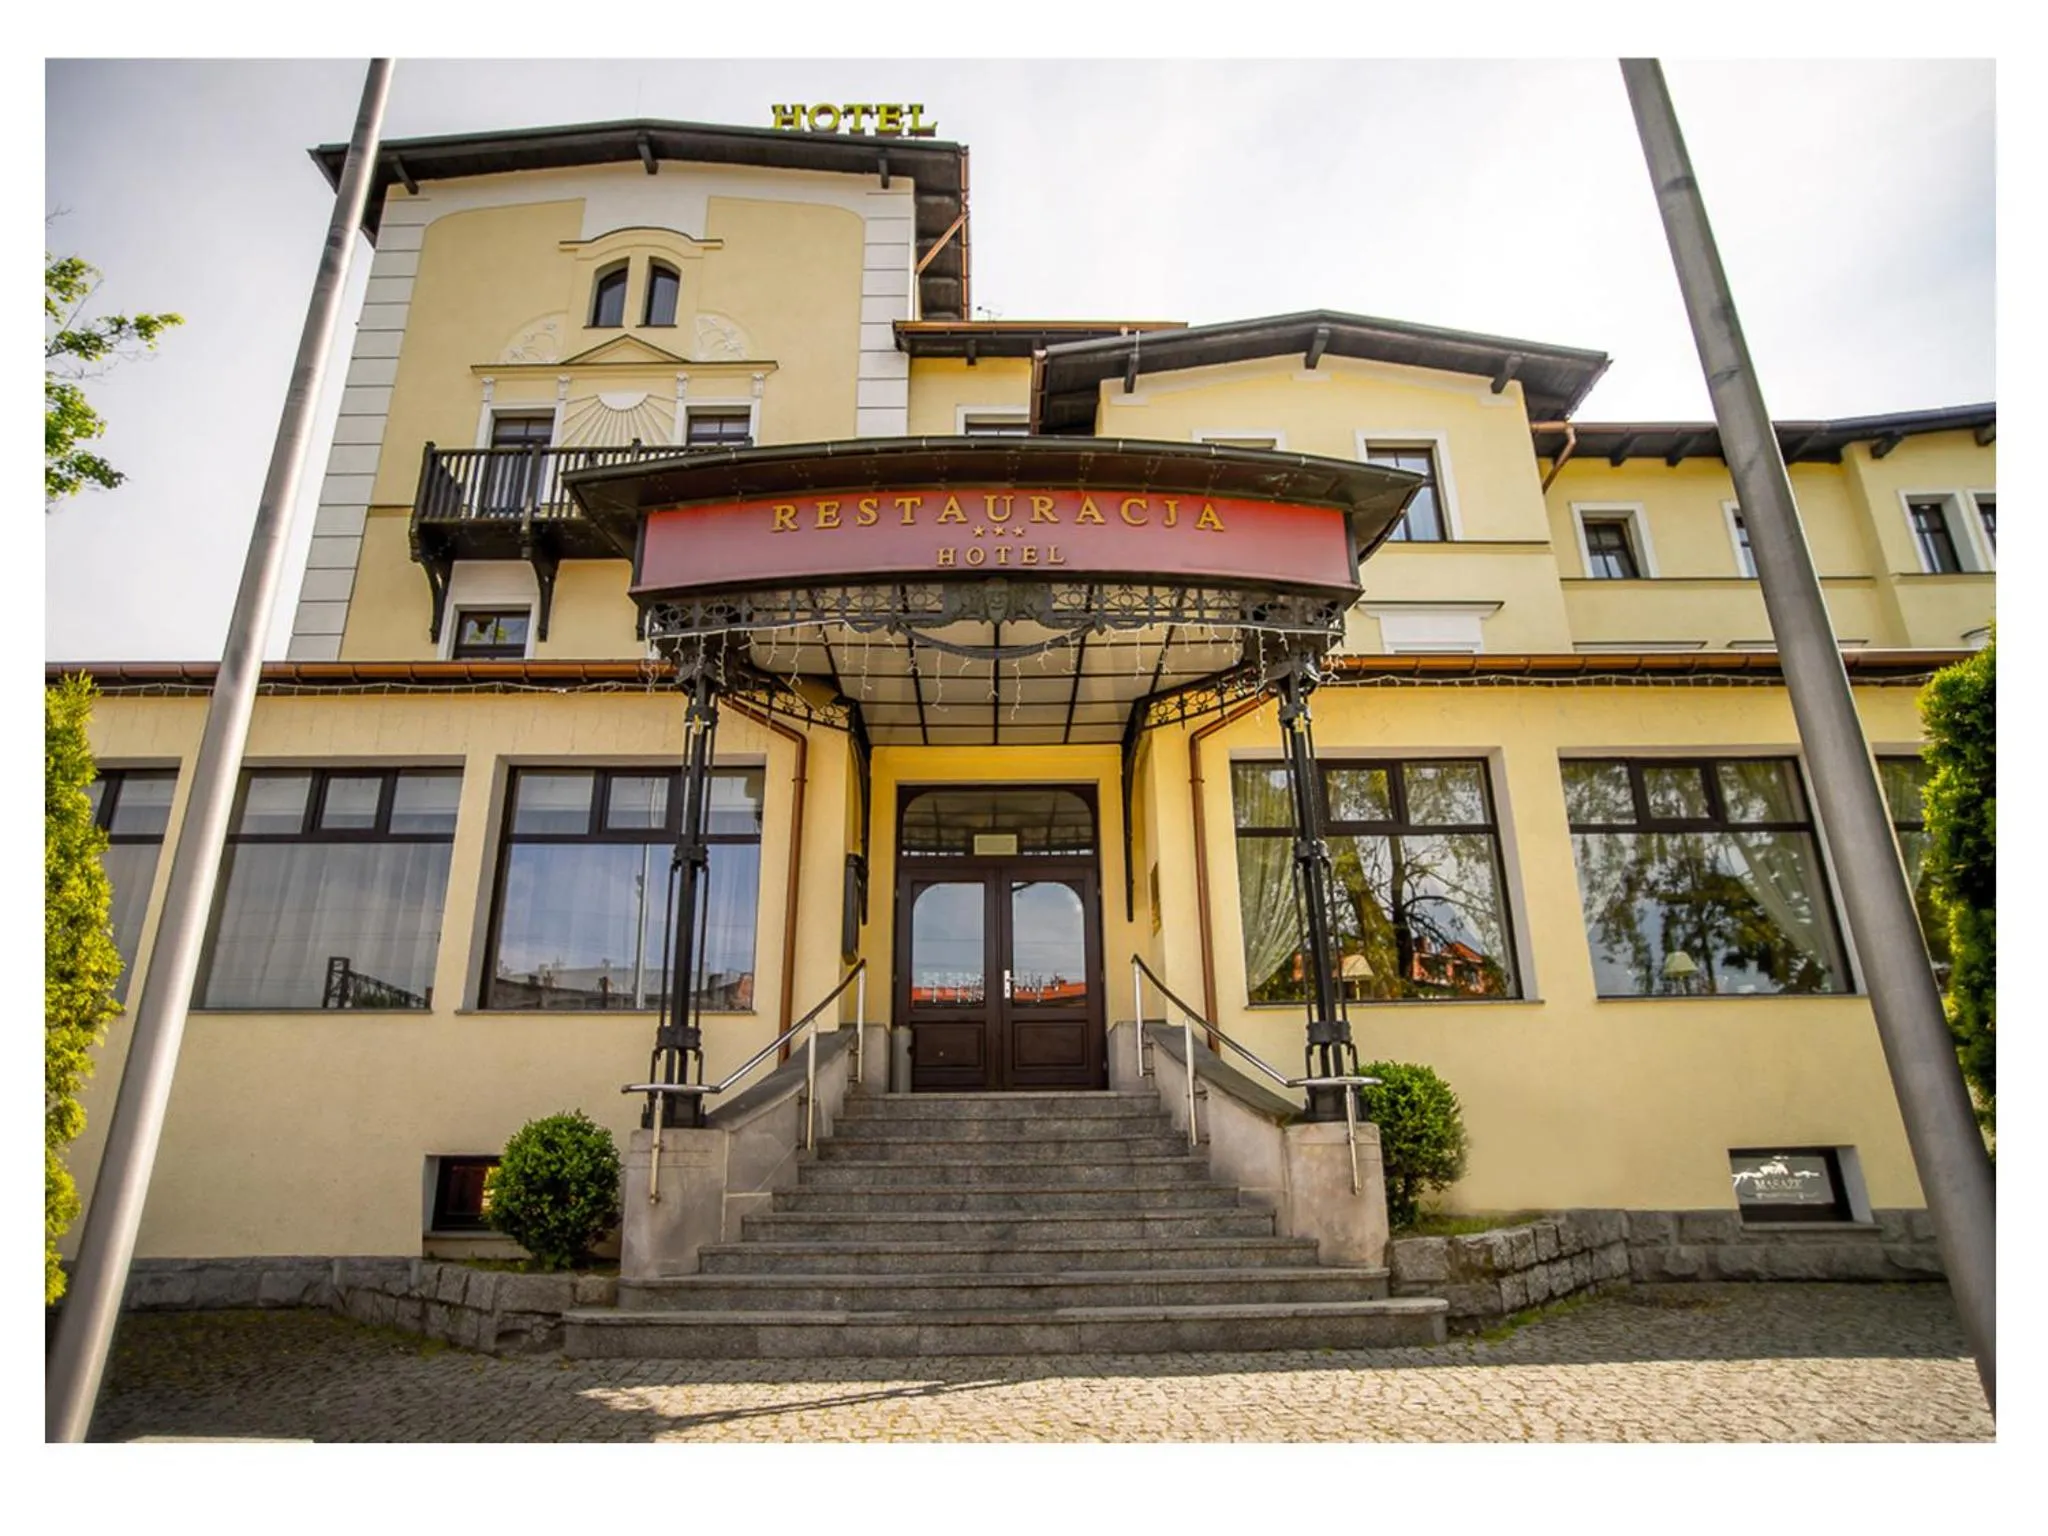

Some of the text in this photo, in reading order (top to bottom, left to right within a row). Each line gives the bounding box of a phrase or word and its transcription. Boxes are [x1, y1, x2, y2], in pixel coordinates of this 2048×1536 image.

[771, 103, 938, 137] HOTEL
[771, 495, 1226, 533] RESTAURACJA
[937, 545, 1066, 567] HOTEL
